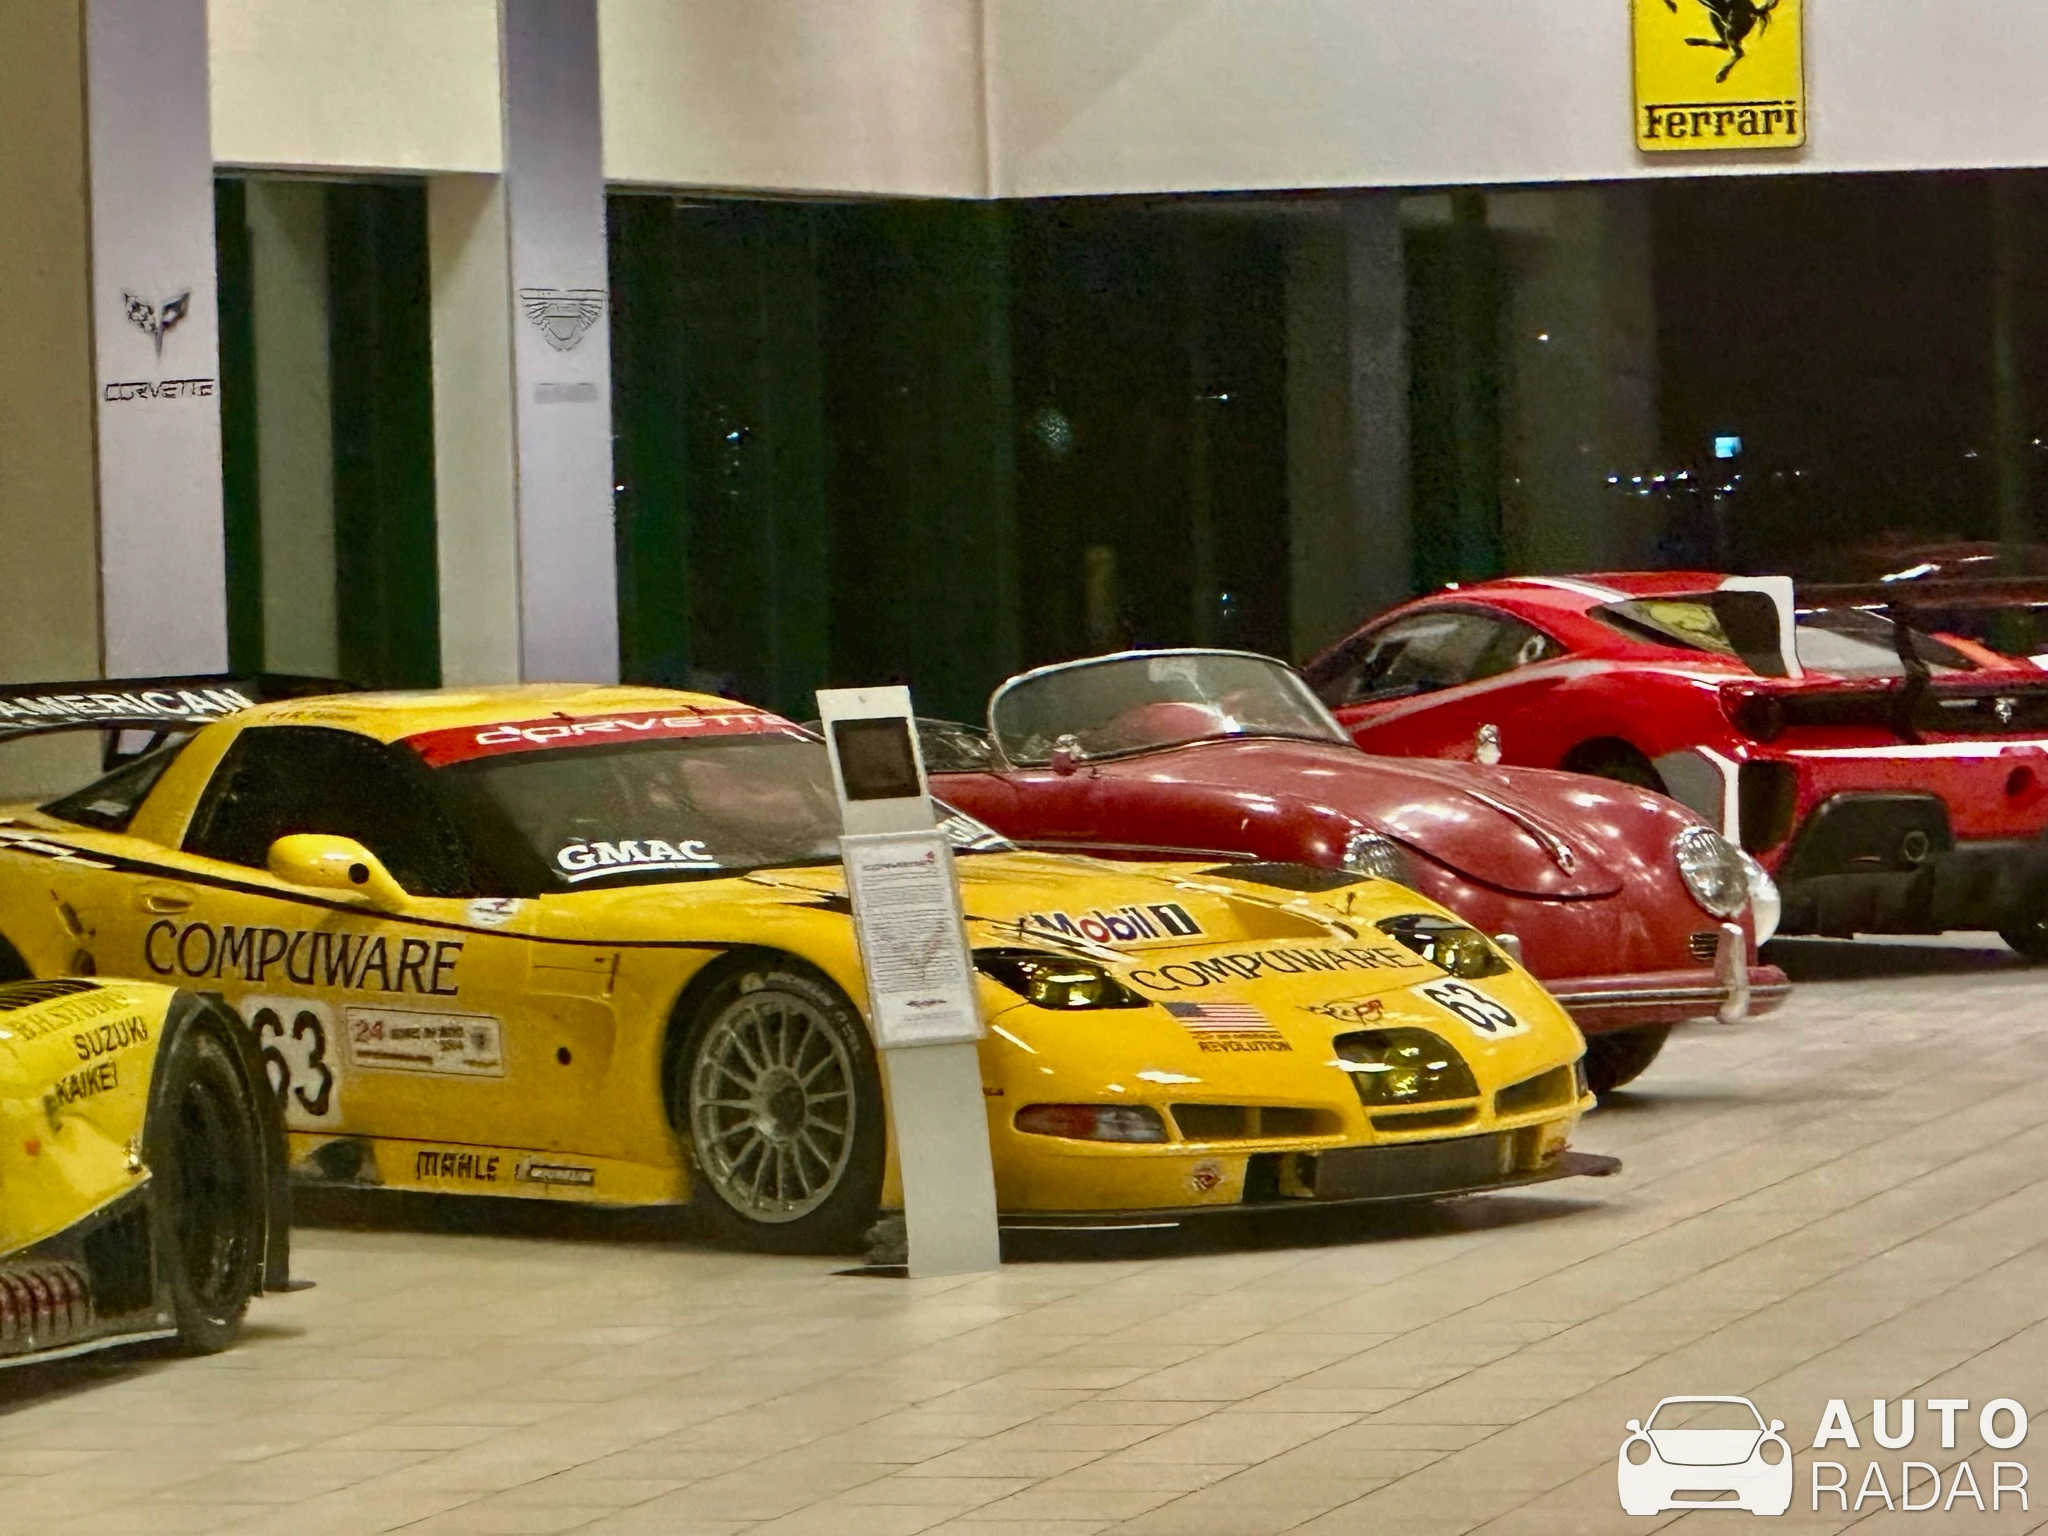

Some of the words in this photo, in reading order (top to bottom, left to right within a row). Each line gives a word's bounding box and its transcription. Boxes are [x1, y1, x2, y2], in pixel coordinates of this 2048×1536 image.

[1643, 100, 1798, 138] Ferrari
[104, 379, 215, 401] CORVETTE
[0, 688, 256, 717] AMERICAN
[557, 839, 713, 871] GMAC
[1031, 906, 1159, 944] Mobil
[1157, 905, 1193, 935] 1
[144, 919, 464, 996] COMPUWARE
[1128, 947, 1424, 991] COMPUWARE
[1423, 983, 1517, 1032] 63
[73, 1015, 148, 1061] SUZUKI
[355, 1020, 384, 1044] 24
[1198, 1040, 1293, 1053] REVOLUTION
[252, 1007, 333, 1116] 63
[56, 1061, 119, 1104] KAIKEI
[416, 1151, 499, 1181] MAHLE
